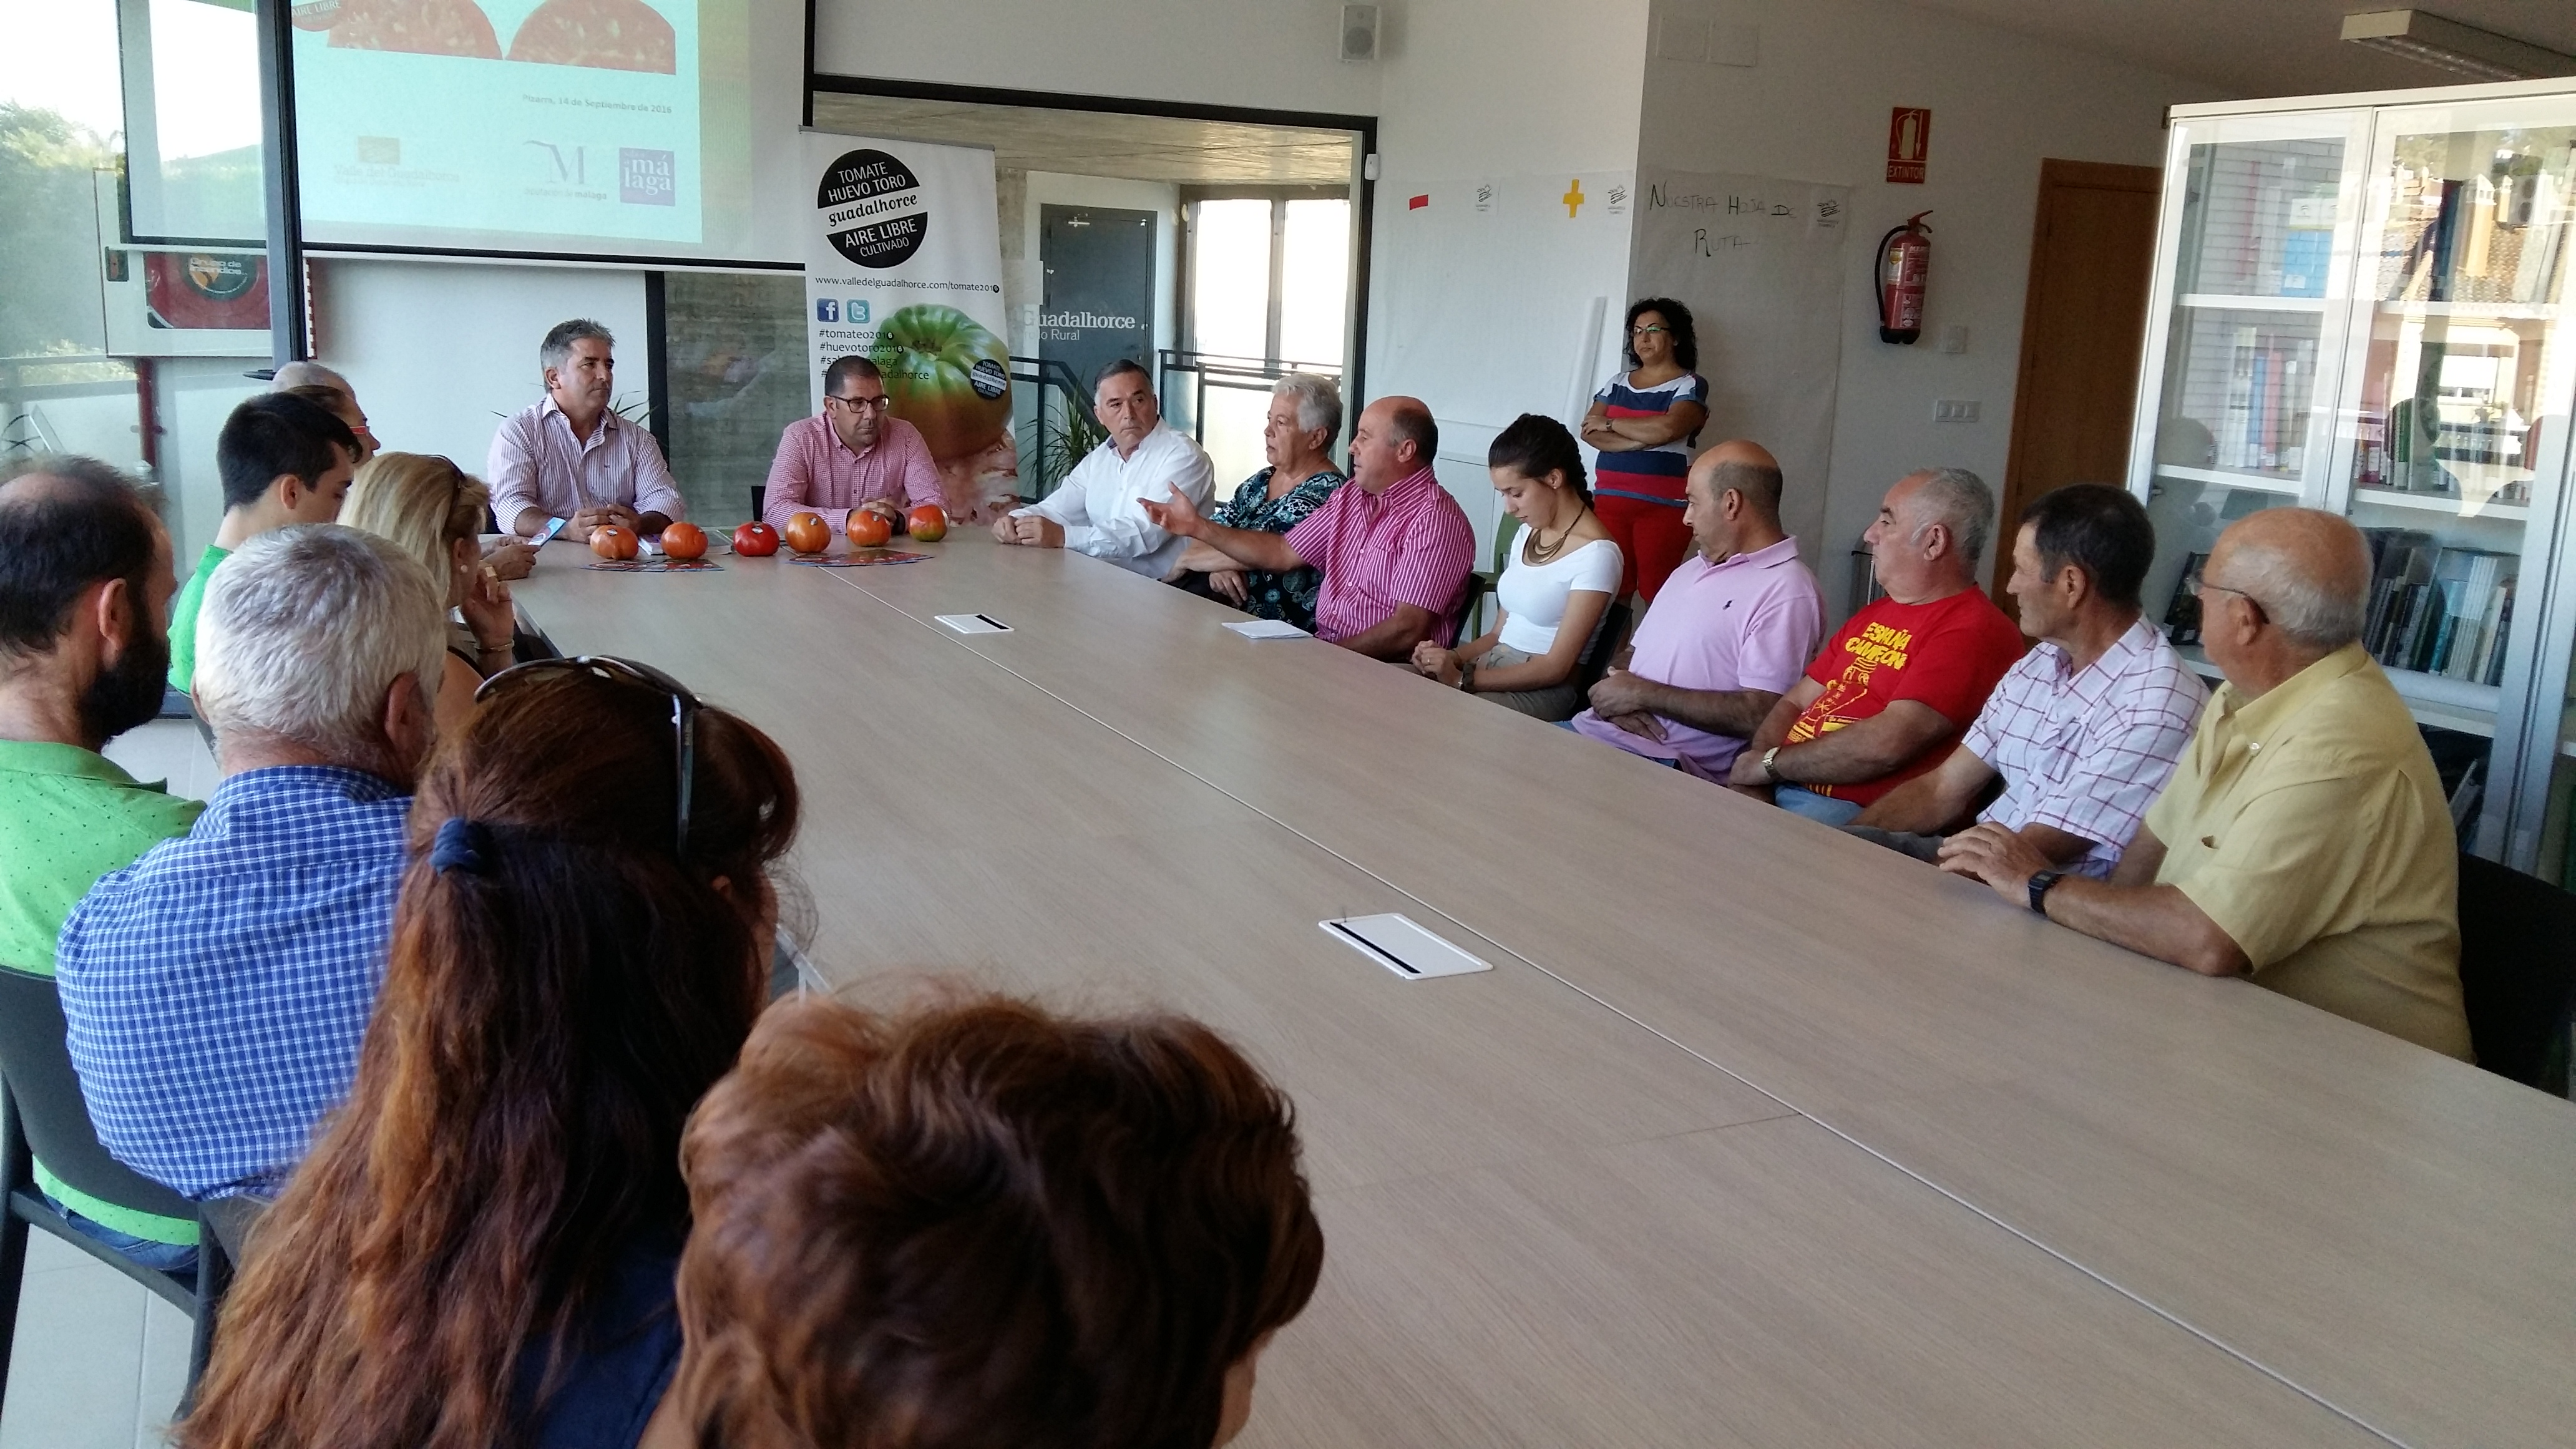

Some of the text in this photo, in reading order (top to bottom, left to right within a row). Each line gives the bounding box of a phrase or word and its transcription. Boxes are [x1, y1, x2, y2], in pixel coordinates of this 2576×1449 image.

[315, 0, 341, 12] LIBRE
[571, 98, 582, 106] de
[585, 99, 635, 111] Septiembre
[638, 104, 648, 112] de
[651, 105, 672, 114] 2016
[837, 161, 888, 184] TOMATE
[1888, 165, 1925, 179] EXTINTOR
[827, 174, 905, 203] HUEVO TORO
[829, 194, 917, 227] guadalhorce
[846, 218, 918, 248] AIRE LIBRE
[860, 237, 909, 257] CULTIVADO
[815, 277, 1000, 293] www.valledelguadalhorce.com/tomate2016
[1051, 329, 1080, 341] Rural
[819, 342, 904, 354] #huevotoro2016
[975, 364, 992, 374] HUEVO
[982, 361, 1000, 371] TOMATE
[972, 372, 1005, 387] guadalhorce
[974, 381, 1002, 395] AIRE LIBRE
[1862, 622, 1912, 651] ESPAÑA
